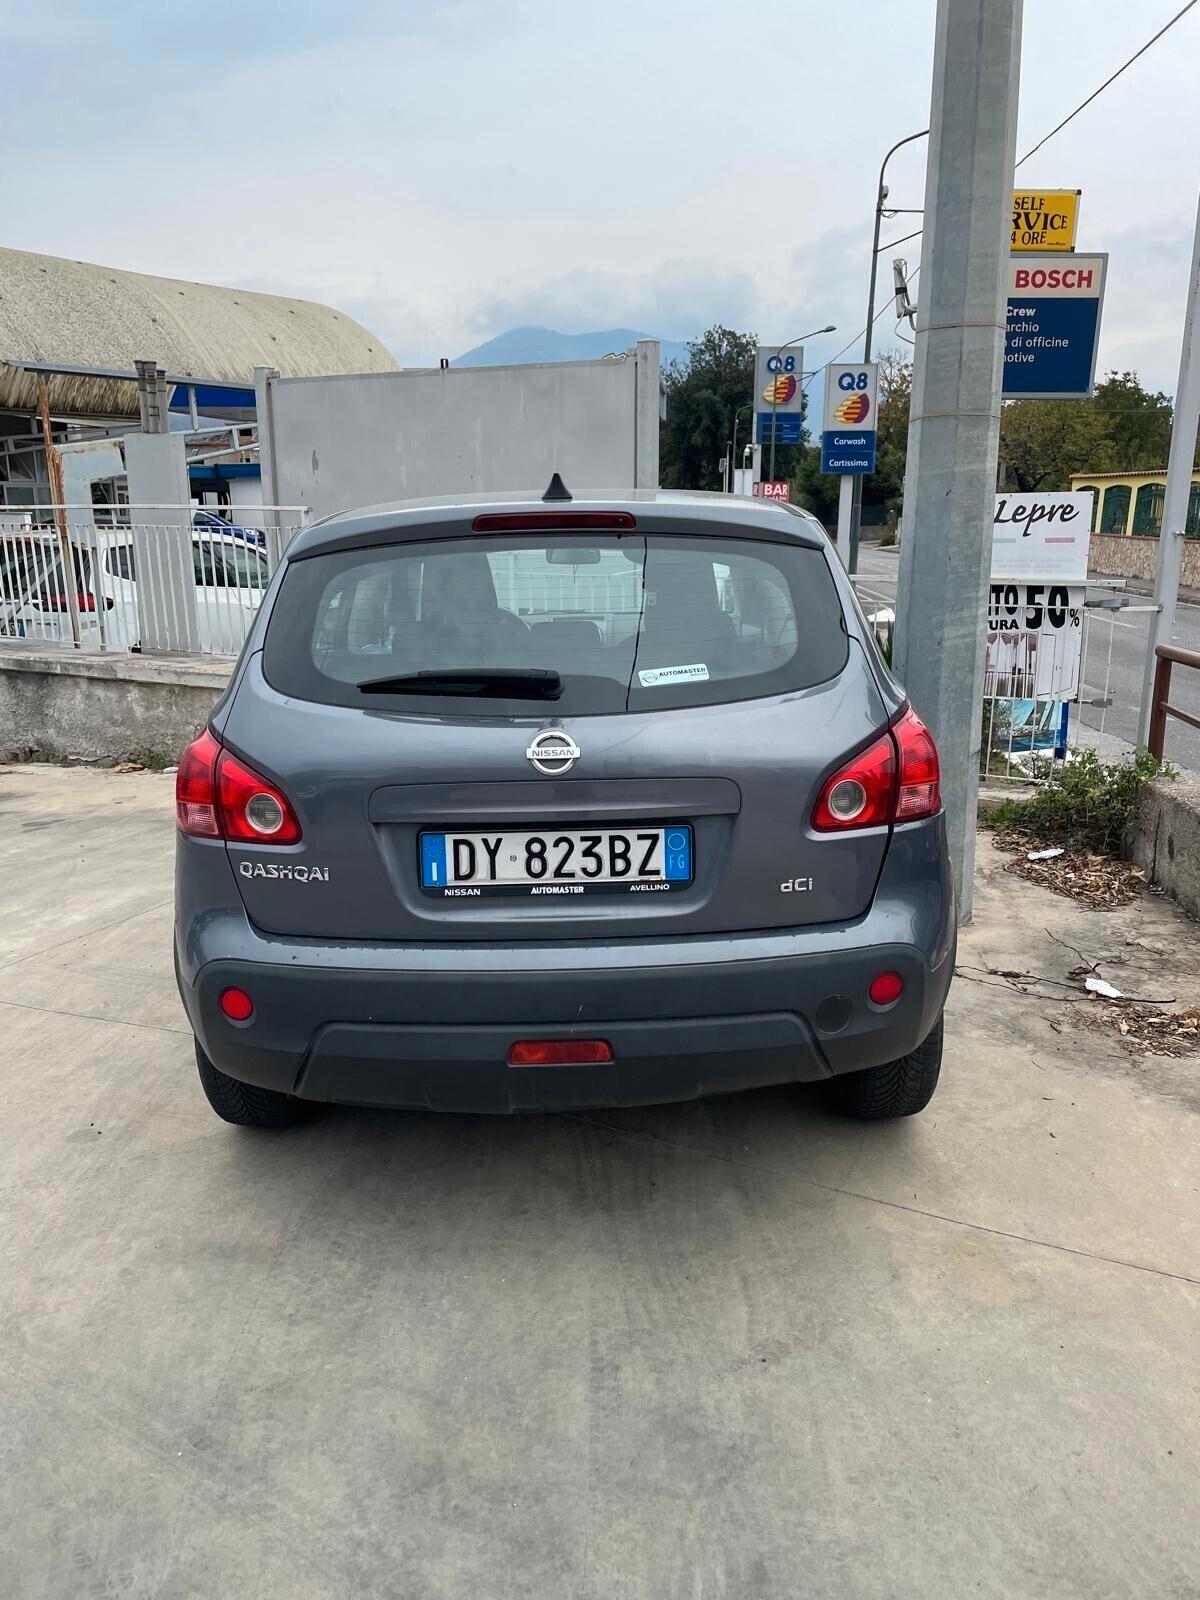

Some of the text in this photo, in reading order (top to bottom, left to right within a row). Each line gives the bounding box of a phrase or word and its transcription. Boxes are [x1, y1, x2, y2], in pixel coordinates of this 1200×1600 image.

[1014, 196, 1045, 211] SELF
[1021, 231, 1047, 245] ORE
[1015, 269, 1093, 289] BOSCH
[1006, 306, 1036, 317] Crew
[1011, 336, 1022, 347] di
[1025, 336, 1069, 347] officine
[1004, 352, 1035, 362] otive
[767, 356, 795, 374] Q8
[838, 372, 868, 391] Q8
[834, 437, 866, 446] Carwash
[829, 459, 868, 468] Cartissima
[764, 484, 788, 496] BAR
[993, 499, 1080, 537] Lepre
[989, 585, 1019, 616] TO
[988, 619, 1019, 631] URA
[659, 667, 706, 677] AUTOMASTER
[532, 749, 575, 757] NISSAN
[453, 838, 503, 881] DY
[525, 833, 661, 879] 823BZ
[669, 853, 685, 870] FG
[240, 862, 329, 882] QASHQAI
[444, 883, 670, 896] NISSAN AUTOMASTER AVELLINO
[781, 877, 813, 892] dCi
